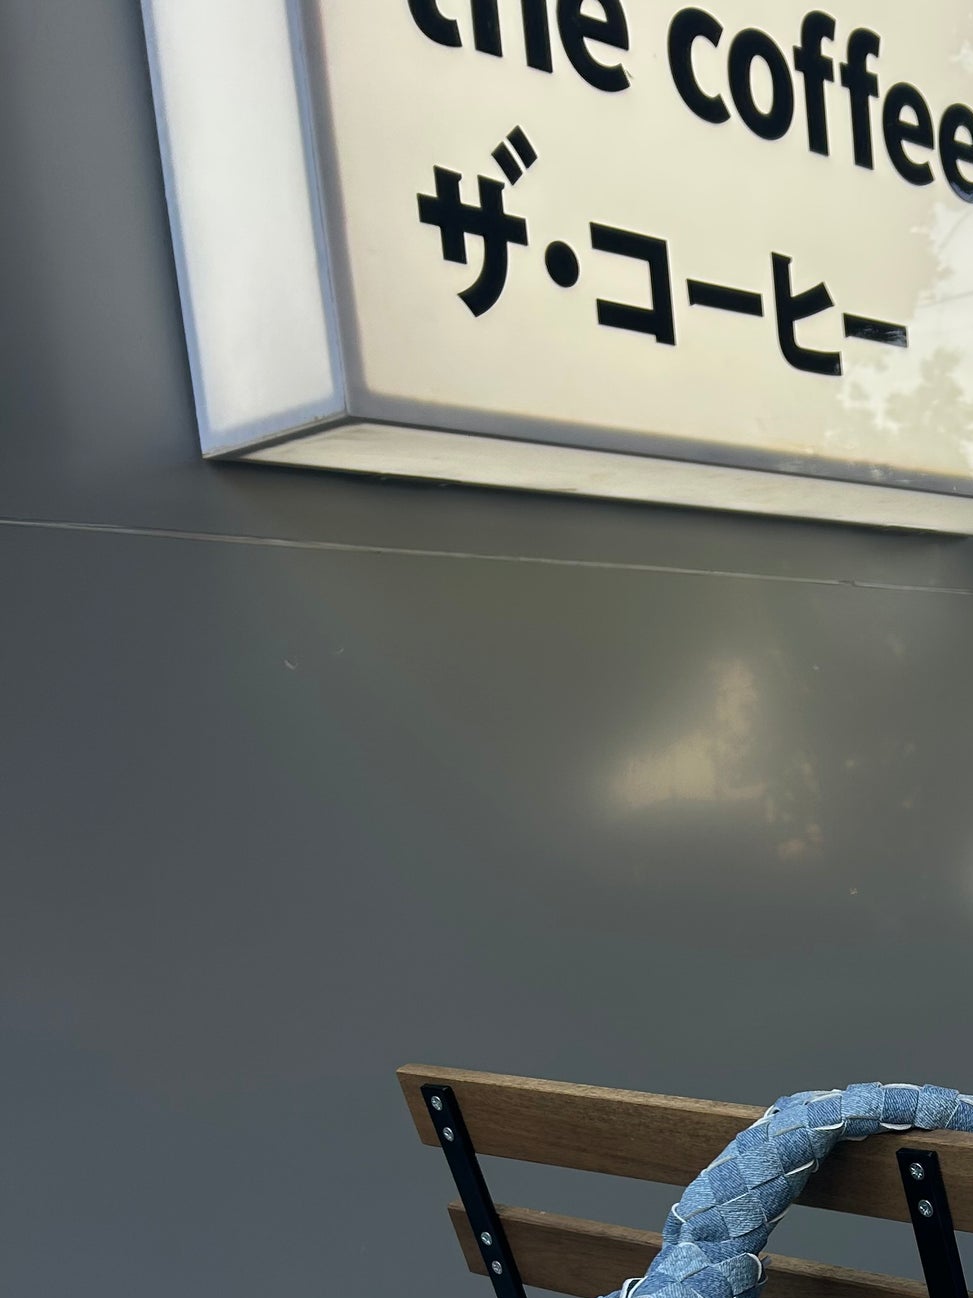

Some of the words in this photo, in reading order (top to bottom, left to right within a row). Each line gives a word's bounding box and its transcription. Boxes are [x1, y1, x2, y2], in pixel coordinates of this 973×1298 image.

[417, 125, 908, 377] ザ・コーヒー
